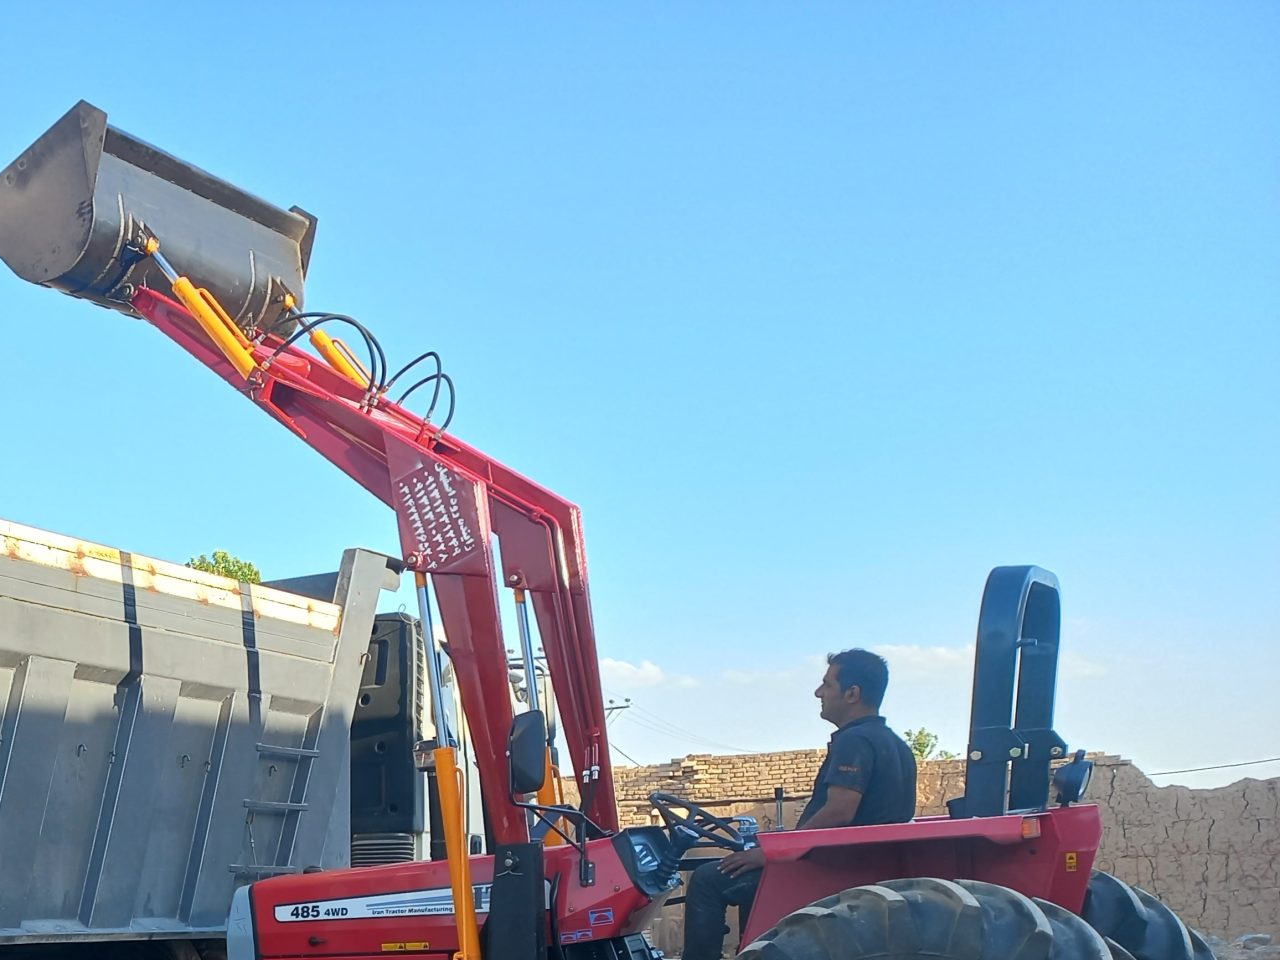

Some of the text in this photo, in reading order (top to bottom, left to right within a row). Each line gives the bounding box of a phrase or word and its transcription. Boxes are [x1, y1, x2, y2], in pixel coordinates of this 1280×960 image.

[291, 905, 349, 919] 485 4WD
[408, 906, 454, 914] Manufacturing
